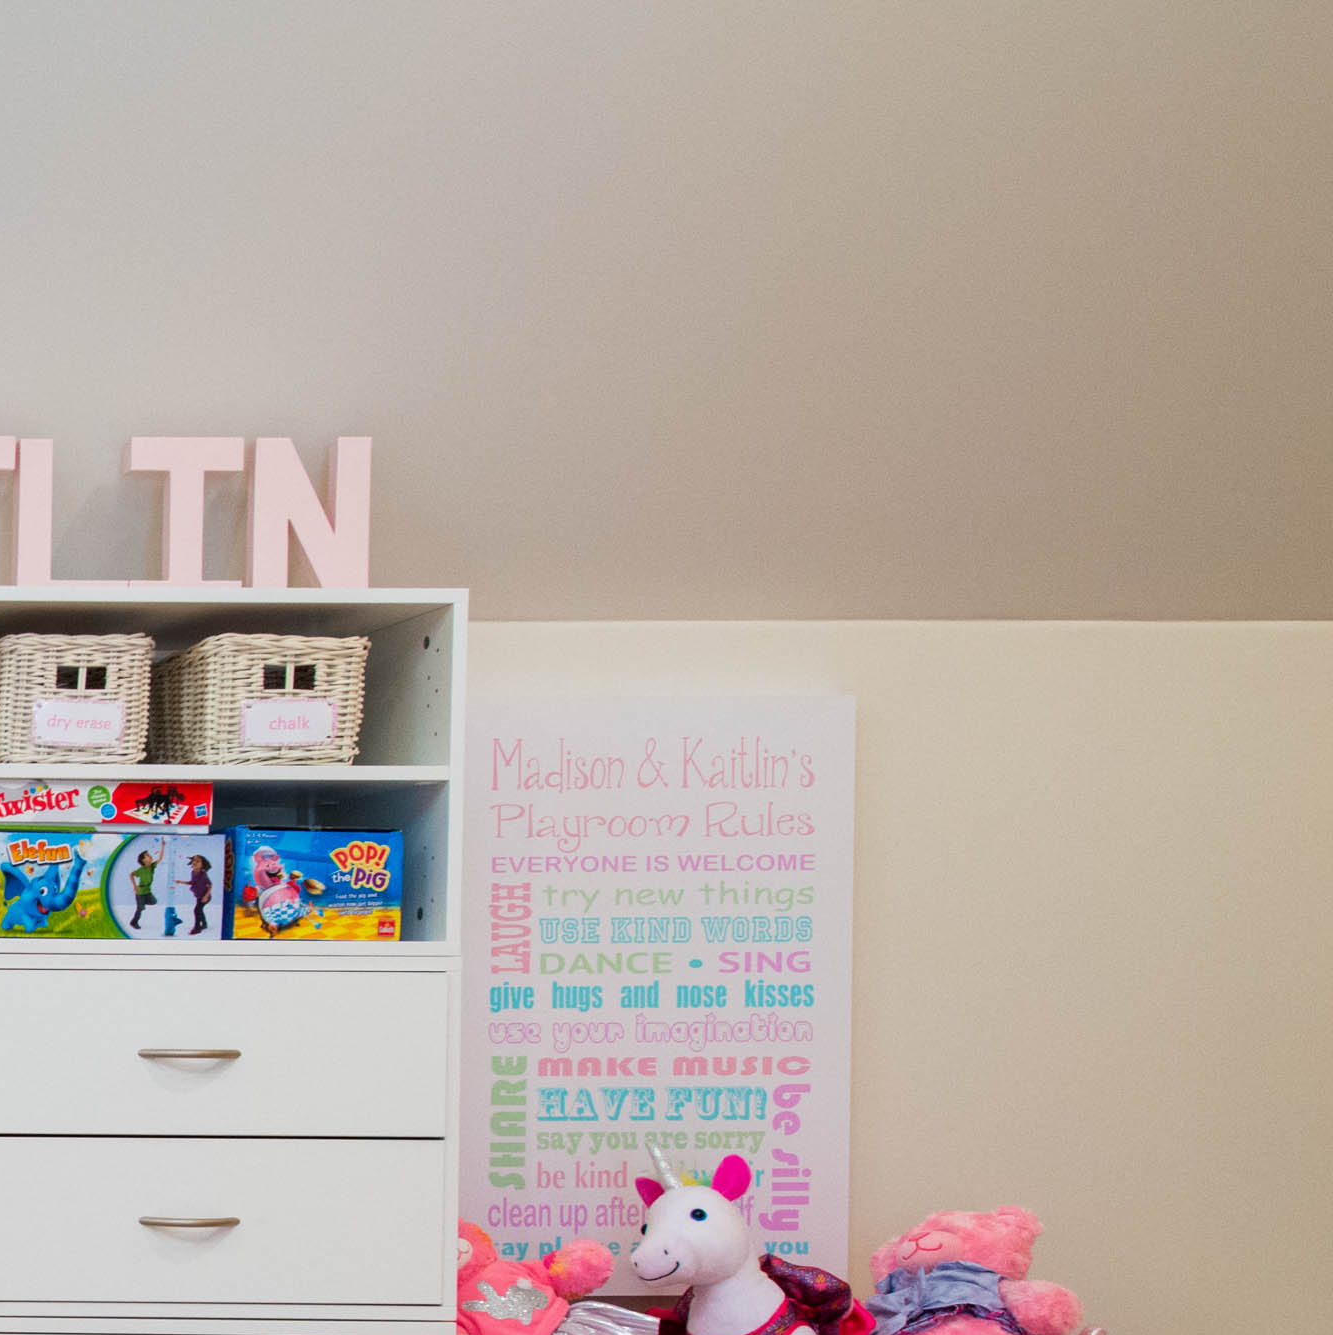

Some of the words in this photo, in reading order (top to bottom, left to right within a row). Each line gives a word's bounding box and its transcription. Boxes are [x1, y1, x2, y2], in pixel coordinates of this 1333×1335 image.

[46, 714, 73, 731] dry
[76, 718, 112, 730] erase
[269, 716, 309, 730] chalk
[492, 738, 624, 792] Madison
[637, 738, 668, 789] &
[682, 736, 815, 789] Kaitlin's
[490, 803, 690, 853] Playroom
[705, 802, 815, 837] Rules
[8, 840, 71, 864] Elefun
[332, 843, 388, 870] POP!
[492, 856, 636, 873] EVERYONE
[646, 856, 669, 872] IS
[678, 854, 813, 871] WELCOME
[541, 884, 600, 914] try
[616, 888, 684, 905] new
[702, 880, 814, 912] things
[490, 882, 531, 974] LAUGH
[538, 917, 600, 945] USE
[611, 917, 693, 945] KIND
[701, 915, 813, 944] WORDS
[541, 952, 670, 975] DANCE
[719, 951, 811, 973] SING
[490, 982, 534, 1013] give
[552, 981, 603, 1012] hugs
[621, 980, 659, 1008] and
[677, 985, 727, 1008] nose
[745, 980, 814, 1007] kisses
[488, 1022, 541, 1044] use
[552, 1022, 624, 1054] your
[635, 1013, 813, 1052] imagination
[538, 1057, 656, 1076] MAKE
[673, 1056, 809, 1076] MUSIC
[538, 1088, 655, 1121] HAVE
[666, 1087, 767, 1120] FUN!
[773, 1084, 810, 1136] be
[489, 1056, 527, 1189] SHARE
[537, 1132, 583, 1156] say
[589, 1132, 637, 1154] you
[645, 1132, 686, 1149] are
[693, 1131, 765, 1154] sorry
[537, 1162, 565, 1189] be
[575, 1161, 627, 1188] kind
[757, 1149, 811, 1231] silly
[487, 1198, 551, 1228] clean
[559, 1205, 587, 1234] up
[493, 1241, 529, 1261] ay
[765, 1241, 810, 1255] you
